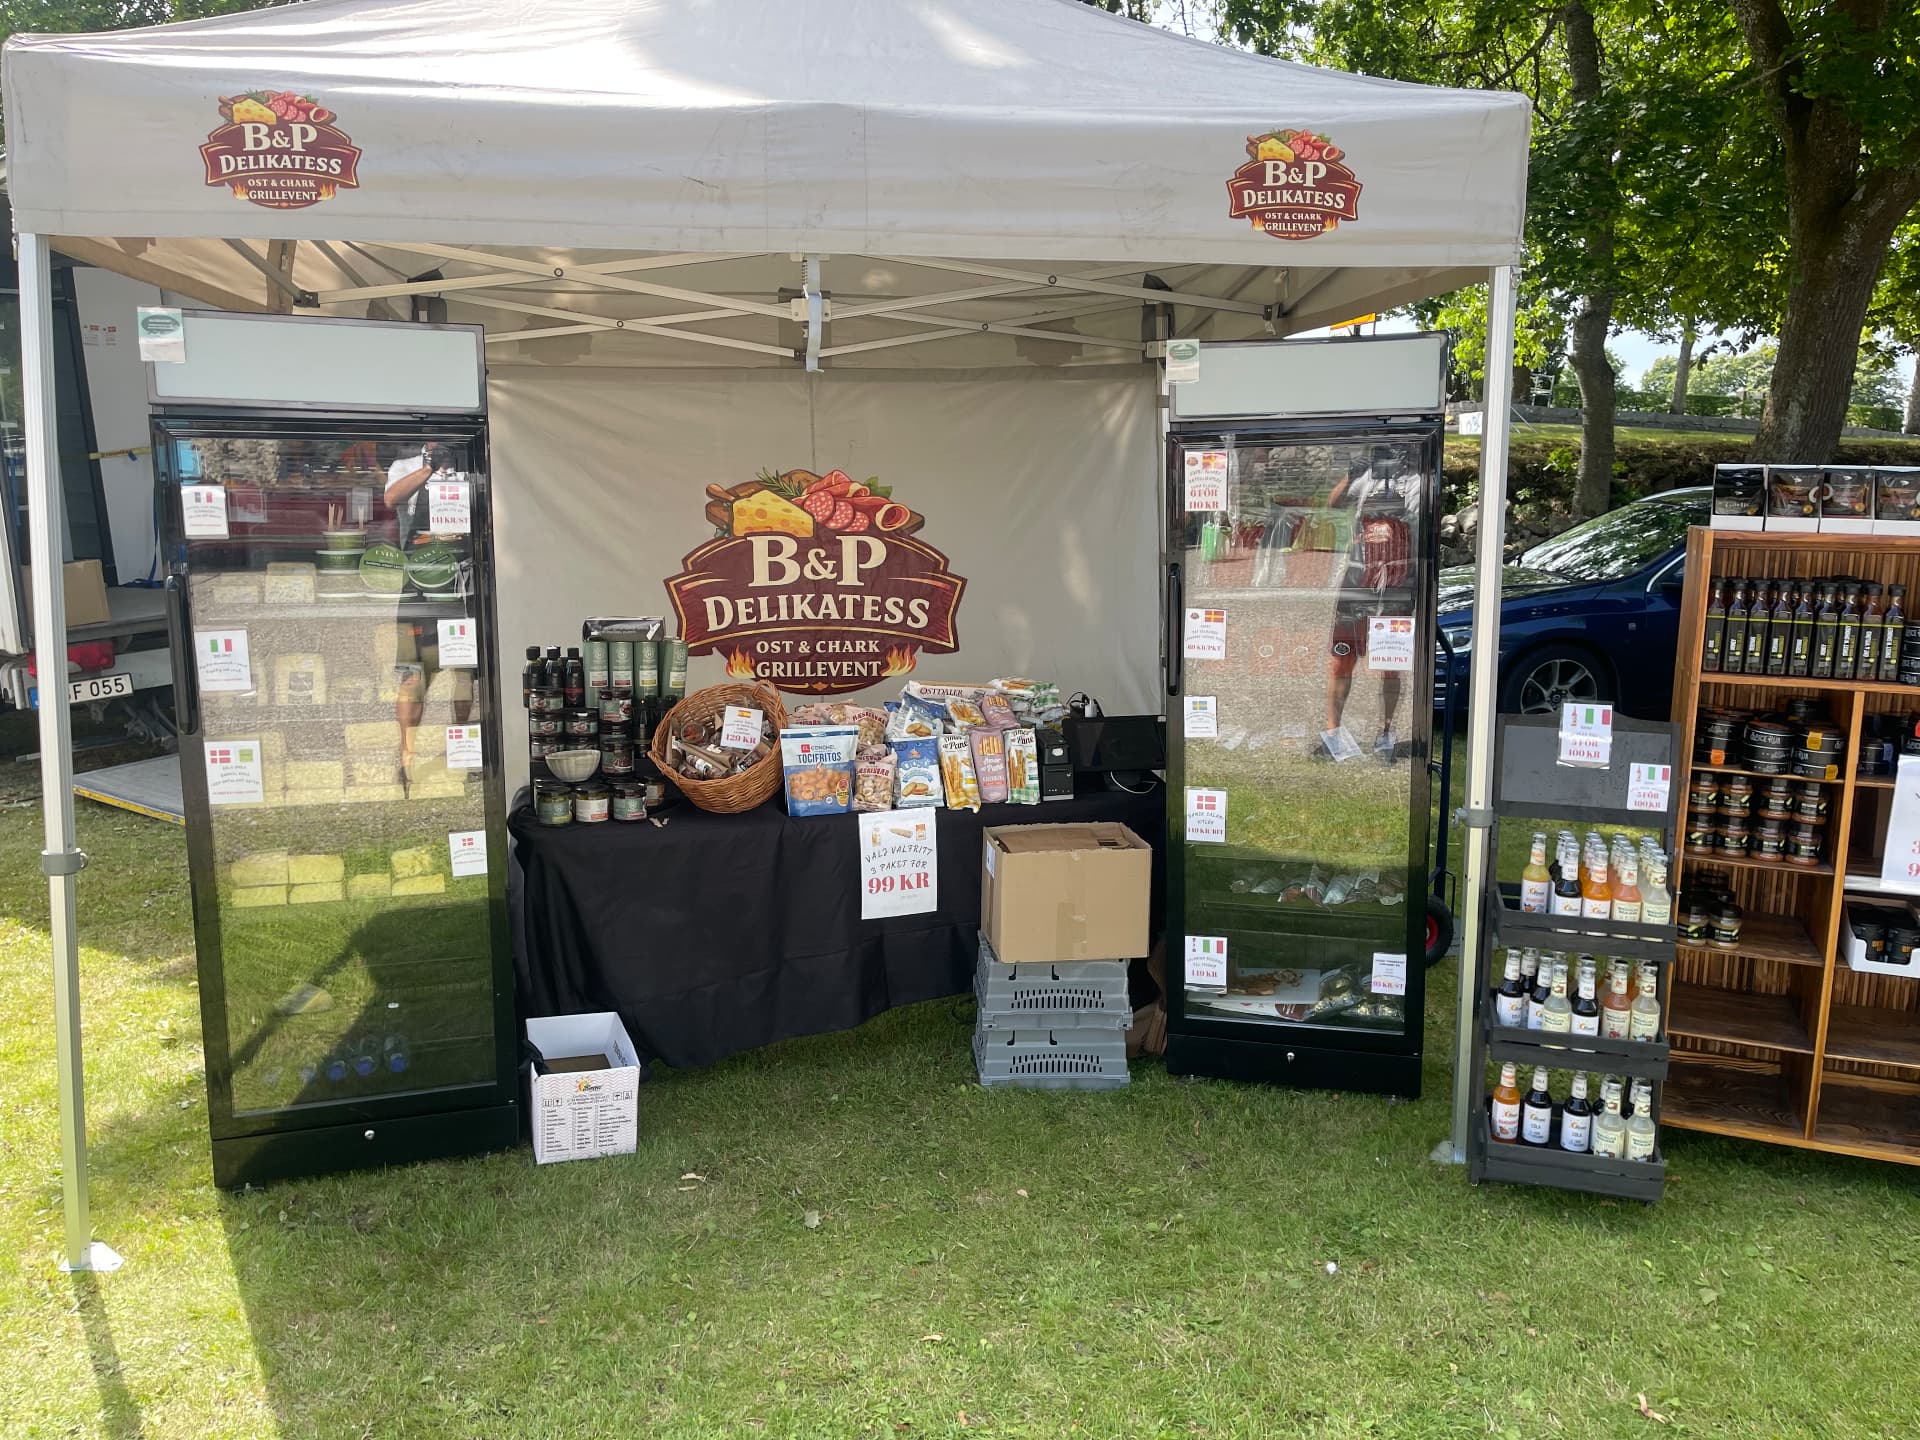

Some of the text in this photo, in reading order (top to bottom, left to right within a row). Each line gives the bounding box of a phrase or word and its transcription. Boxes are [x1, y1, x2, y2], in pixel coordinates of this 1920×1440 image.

[241, 123, 318, 152] B&P
[219, 154, 342, 175] DELIKATESS
[1263, 160, 1327, 187] B&P
[248, 179, 316, 187] OST & CHARK
[249, 190, 318, 201] GRILLEVENT
[1242, 190, 1346, 209] DELIKATESS
[1265, 212, 1283, 220] OST
[1292, 212, 1322, 220] CHARK
[1265, 223, 1323, 232] GRILLEVENT
[1205, 501, 1219, 510] KR
[746, 535, 887, 587] B&P
[703, 594, 930, 632] DELIKATESS
[756, 641, 880, 654] OST & CHARK
[756, 661, 882, 677] GRILLEVENT
[90, 678, 124, 697] 055
[742, 736, 757, 745] KR
[797, 752, 842, 764] TOCIFRITOS
[1586, 750, 1601, 759] KR
[880, 860, 907, 872] PAKET
[868, 872, 929, 895] 99 KR
